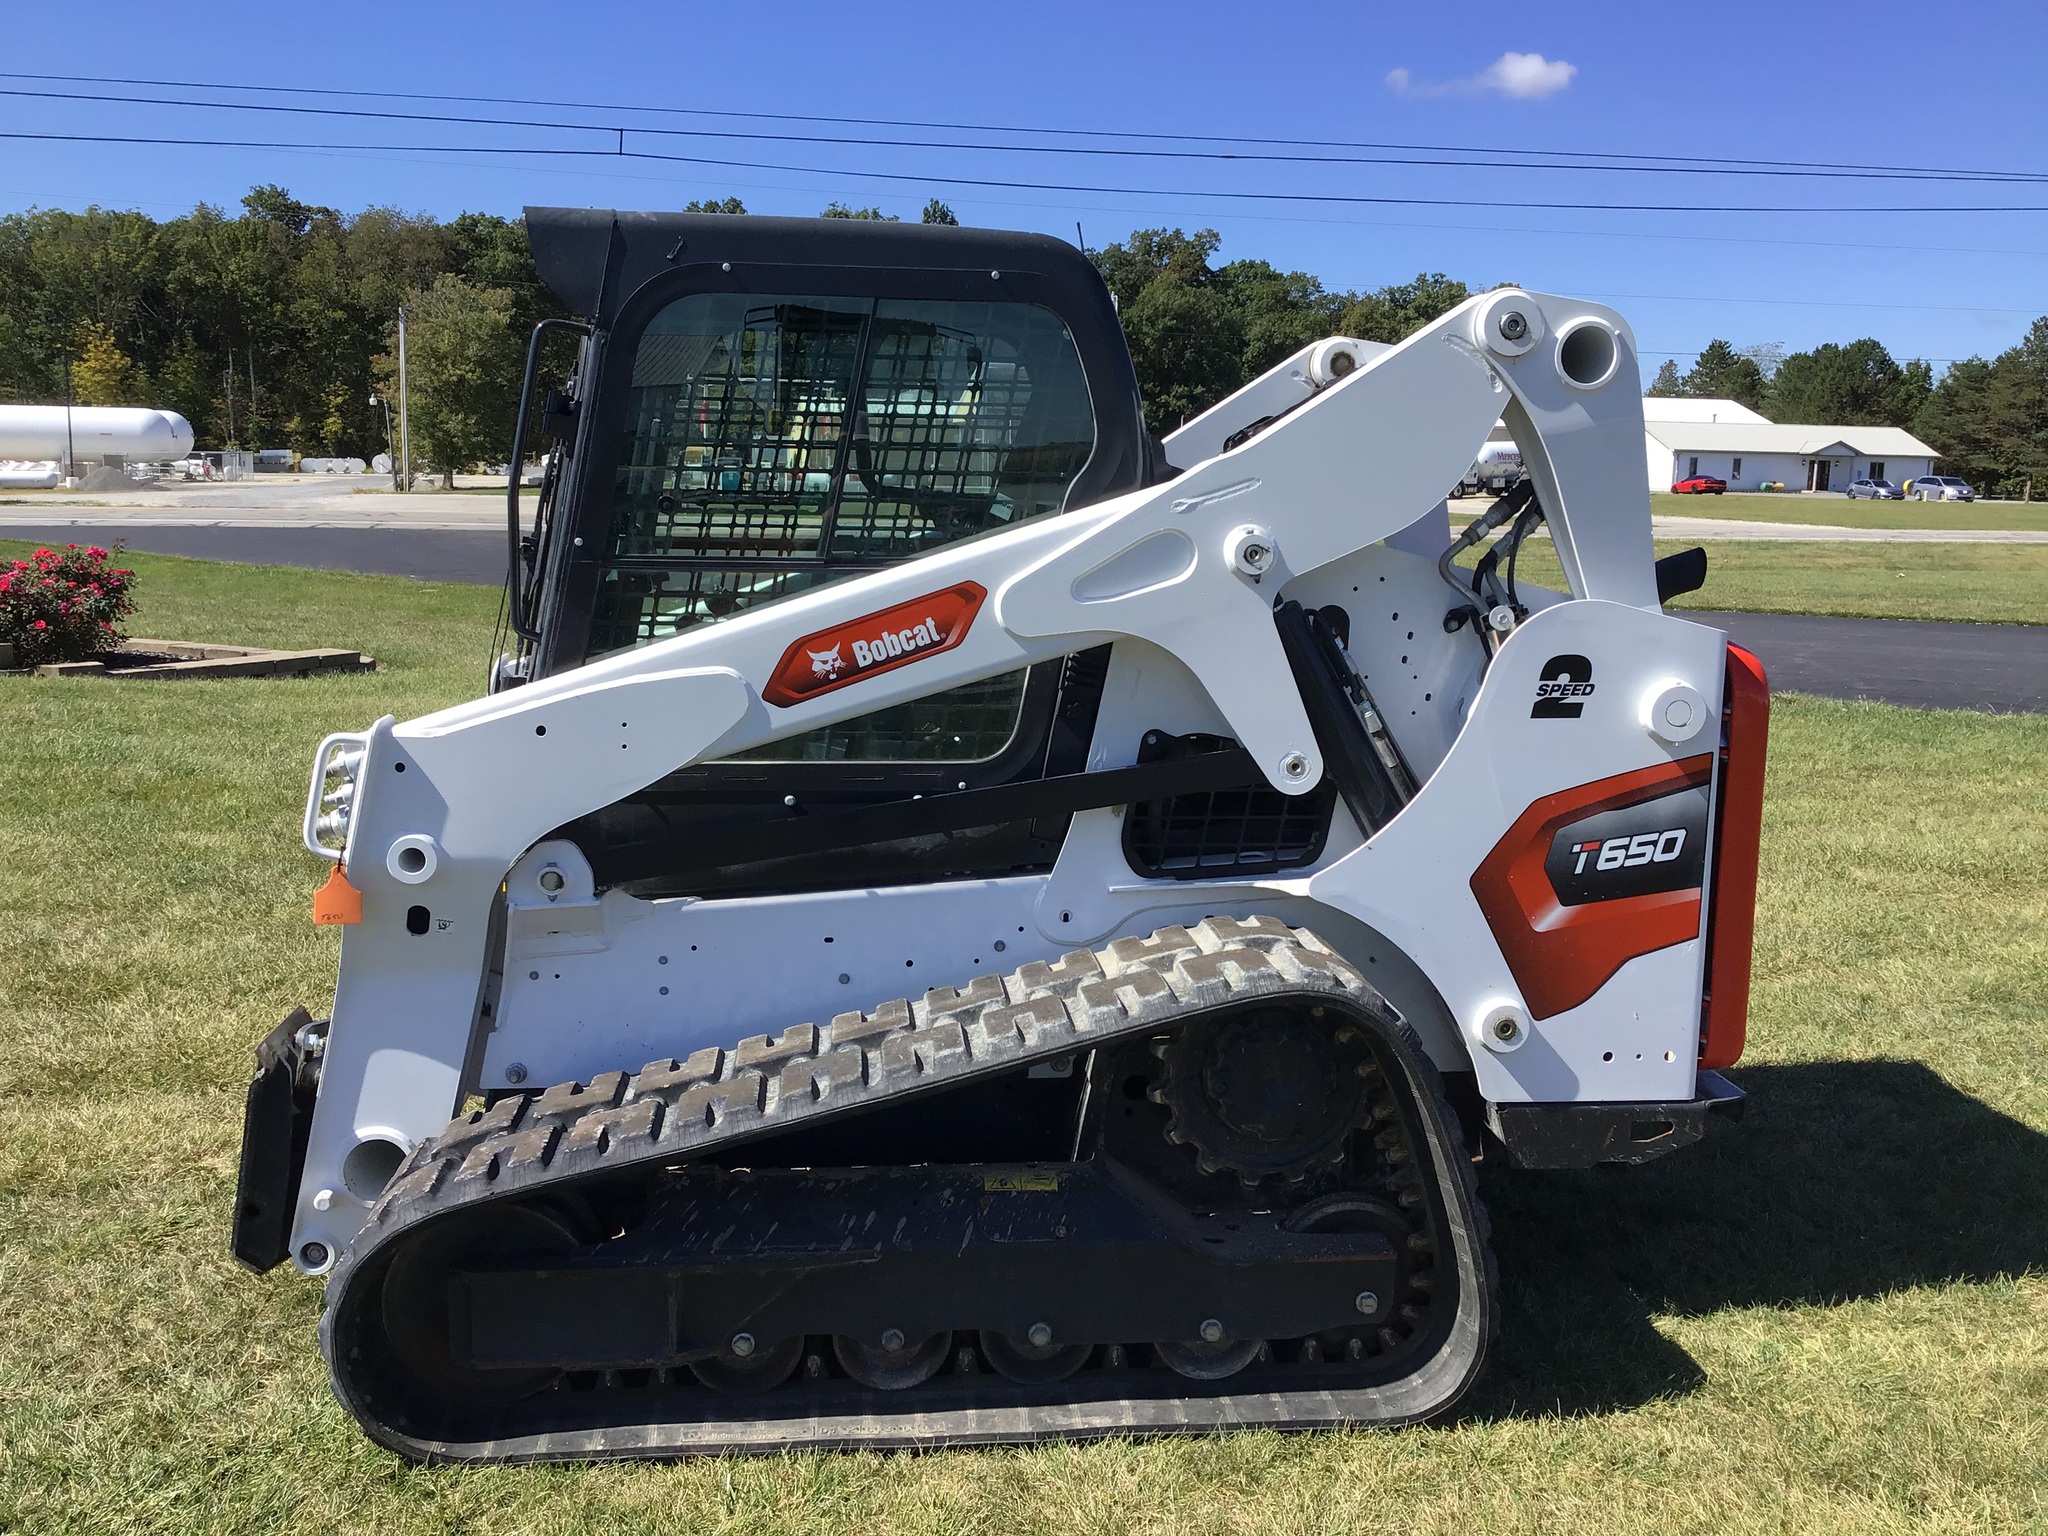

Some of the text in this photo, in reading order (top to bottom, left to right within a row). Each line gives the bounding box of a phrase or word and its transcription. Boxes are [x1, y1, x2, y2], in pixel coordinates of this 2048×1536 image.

[852, 616, 941, 669] Bobcat
[1530, 654, 1592, 719] 2
[1536, 683, 1595, 697] SPEED
[1571, 828, 1688, 875] T650
